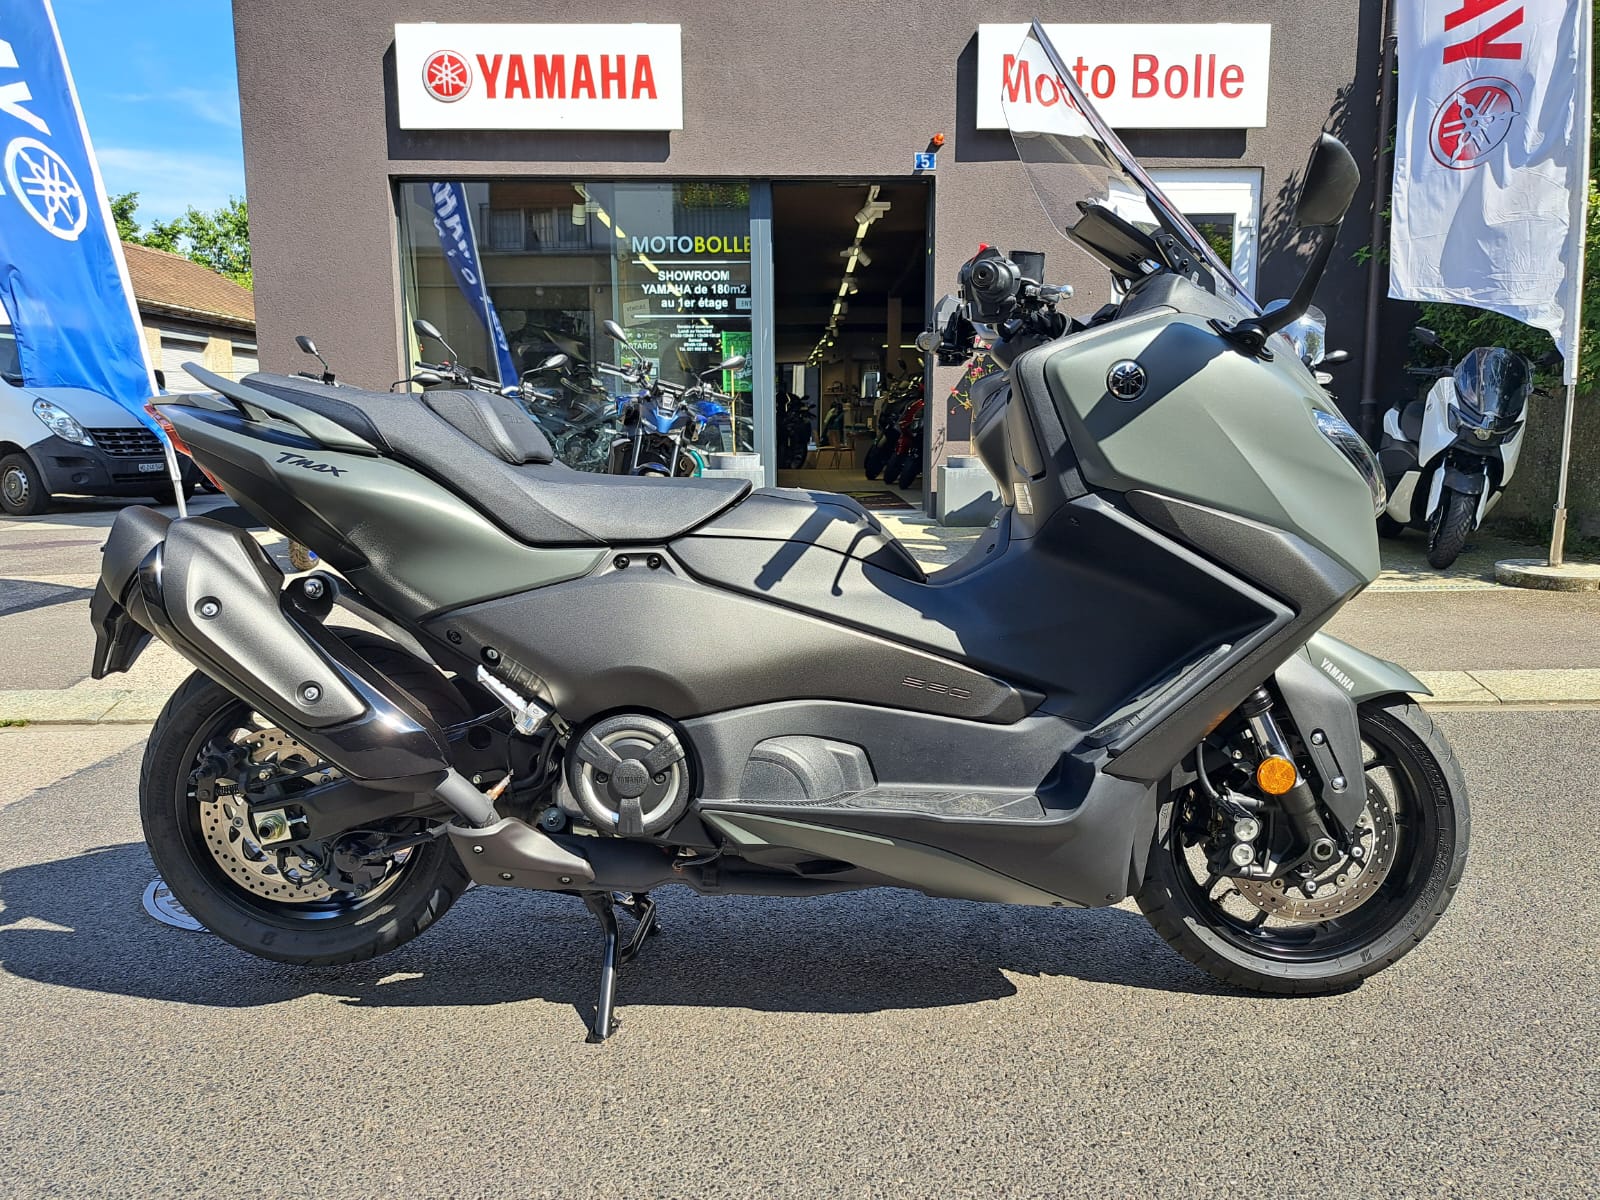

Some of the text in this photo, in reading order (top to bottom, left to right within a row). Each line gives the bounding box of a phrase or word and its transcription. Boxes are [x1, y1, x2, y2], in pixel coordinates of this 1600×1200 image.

[476, 54, 658, 99] YAMAHA
[1003, 53, 1245, 107] Moto Bolle
[920, 154, 930, 168] 5
[658, 270, 730, 281] SHOWROOM
[641, 284, 747, 295] YAMAHA de 180m2
[661, 297, 729, 310] au 1er étage
[1320, 657, 1356, 692] YAMAHA
